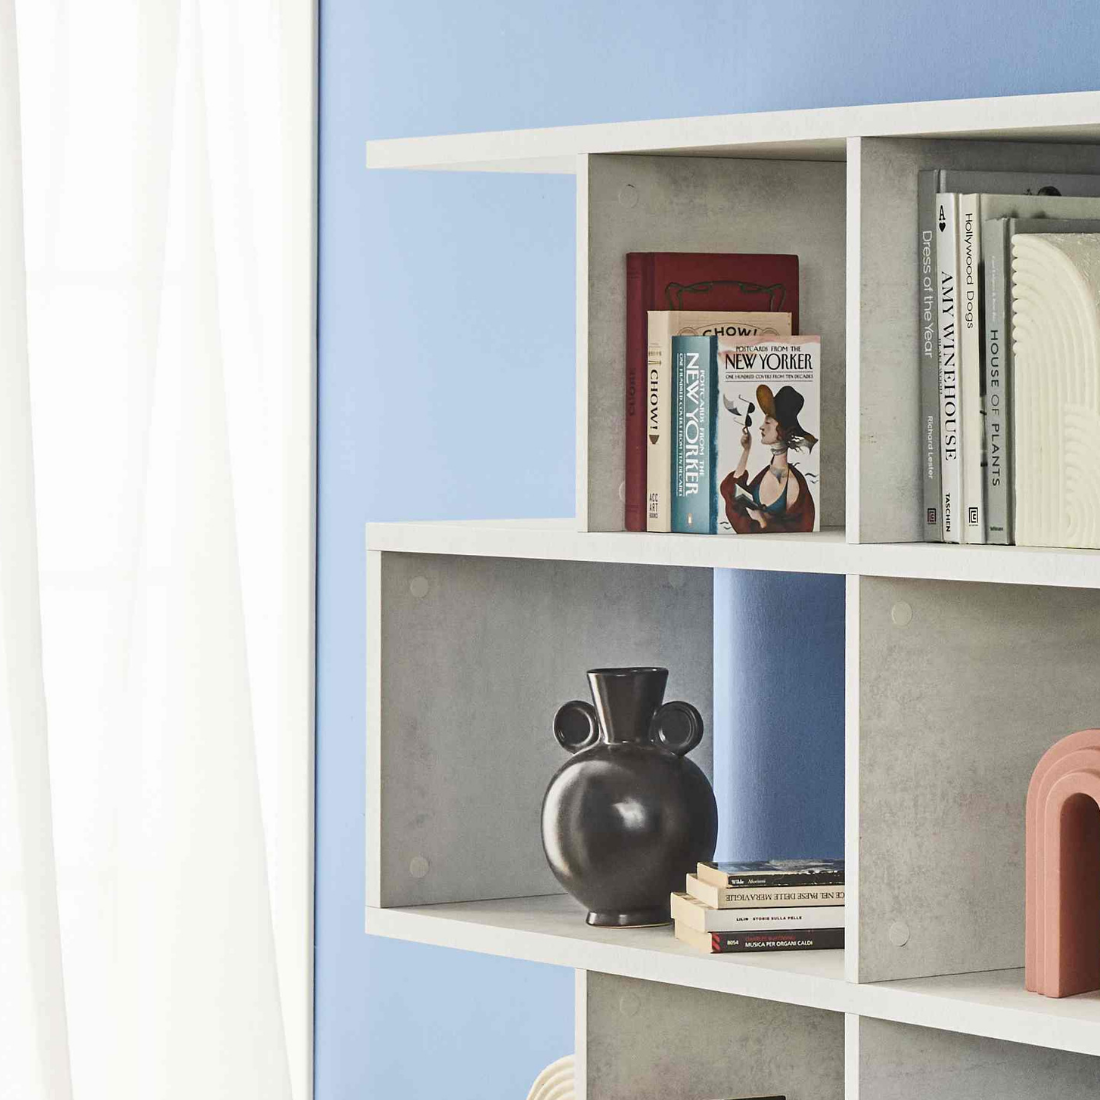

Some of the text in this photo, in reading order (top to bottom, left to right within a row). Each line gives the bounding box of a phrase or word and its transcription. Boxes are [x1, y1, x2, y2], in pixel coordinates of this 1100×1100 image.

[922, 230, 934, 359] Dress of the Year
[964, 213, 974, 329] Hollywood Dogs
[725, 352, 813, 371] NEW YORKER
[941, 271, 957, 461] AMY WINEHOUSE
[990, 329, 999, 388] HOUSE
[650, 369, 659, 430] CHOW!
[685, 352, 699, 497] NEW YORKER
[990, 394, 1000, 416] OF
[991, 423, 1000, 487] PLANTS
[726, 893, 772, 902] MERAVIGLIE
[797, 892, 819, 900] PAESE
